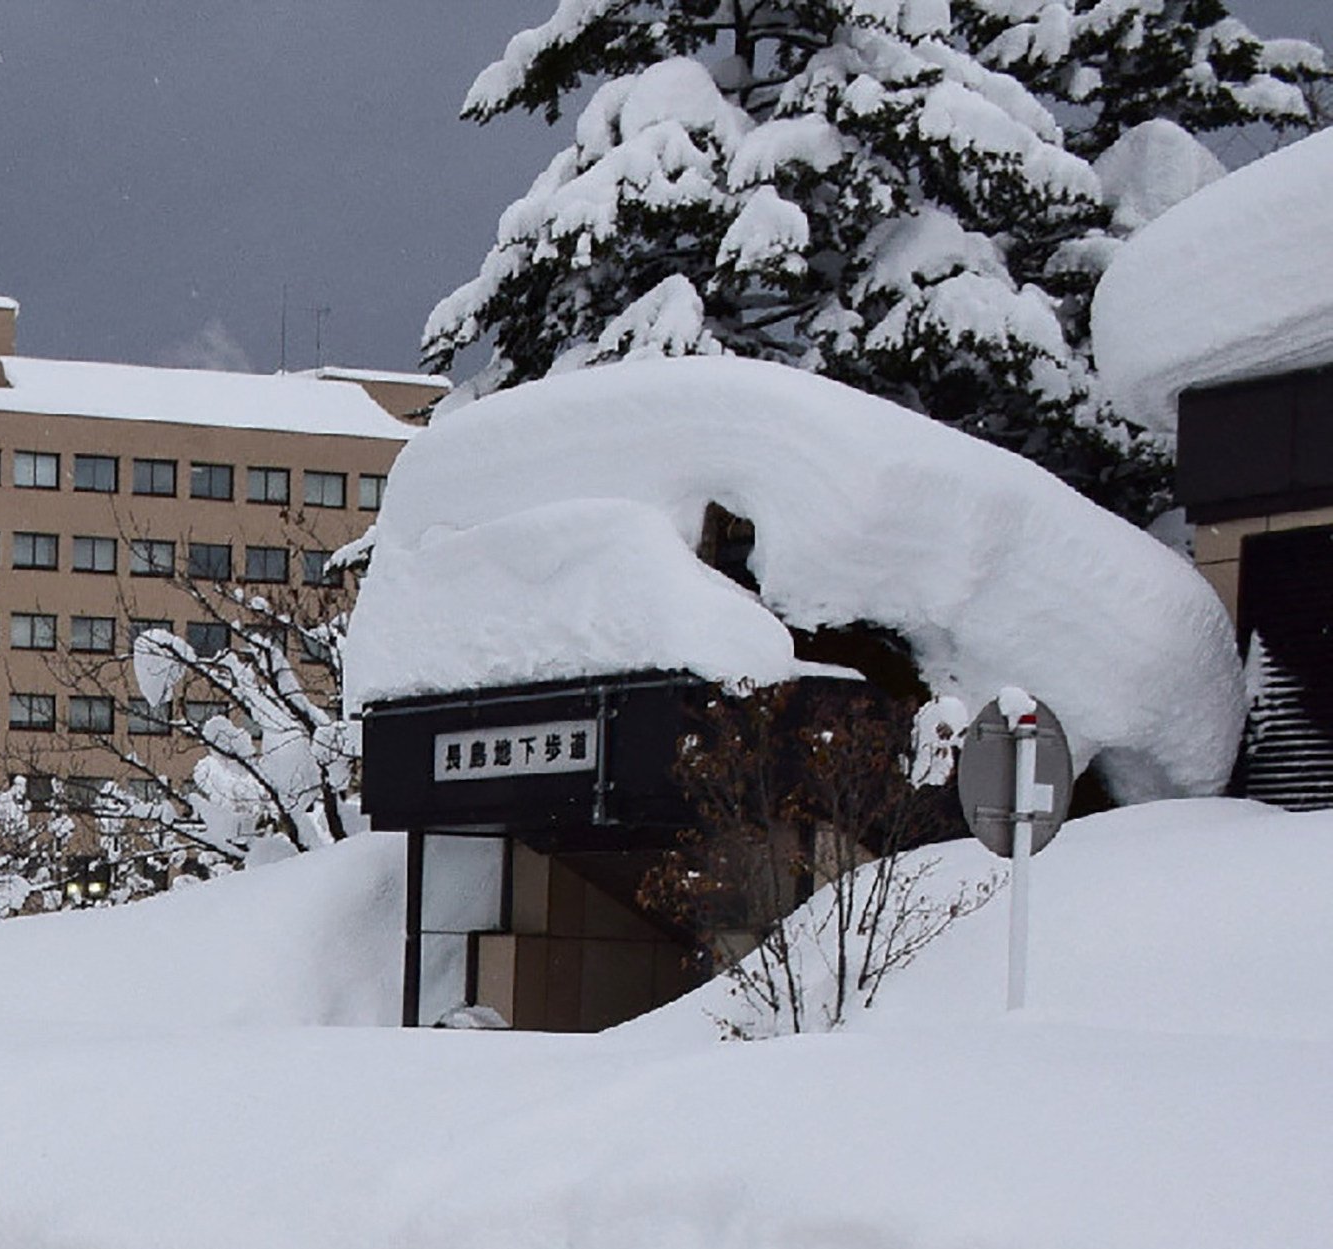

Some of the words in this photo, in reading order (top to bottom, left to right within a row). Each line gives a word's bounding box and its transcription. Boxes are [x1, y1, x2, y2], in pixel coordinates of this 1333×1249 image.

[446, 730, 587, 771] 長島地下歩道
